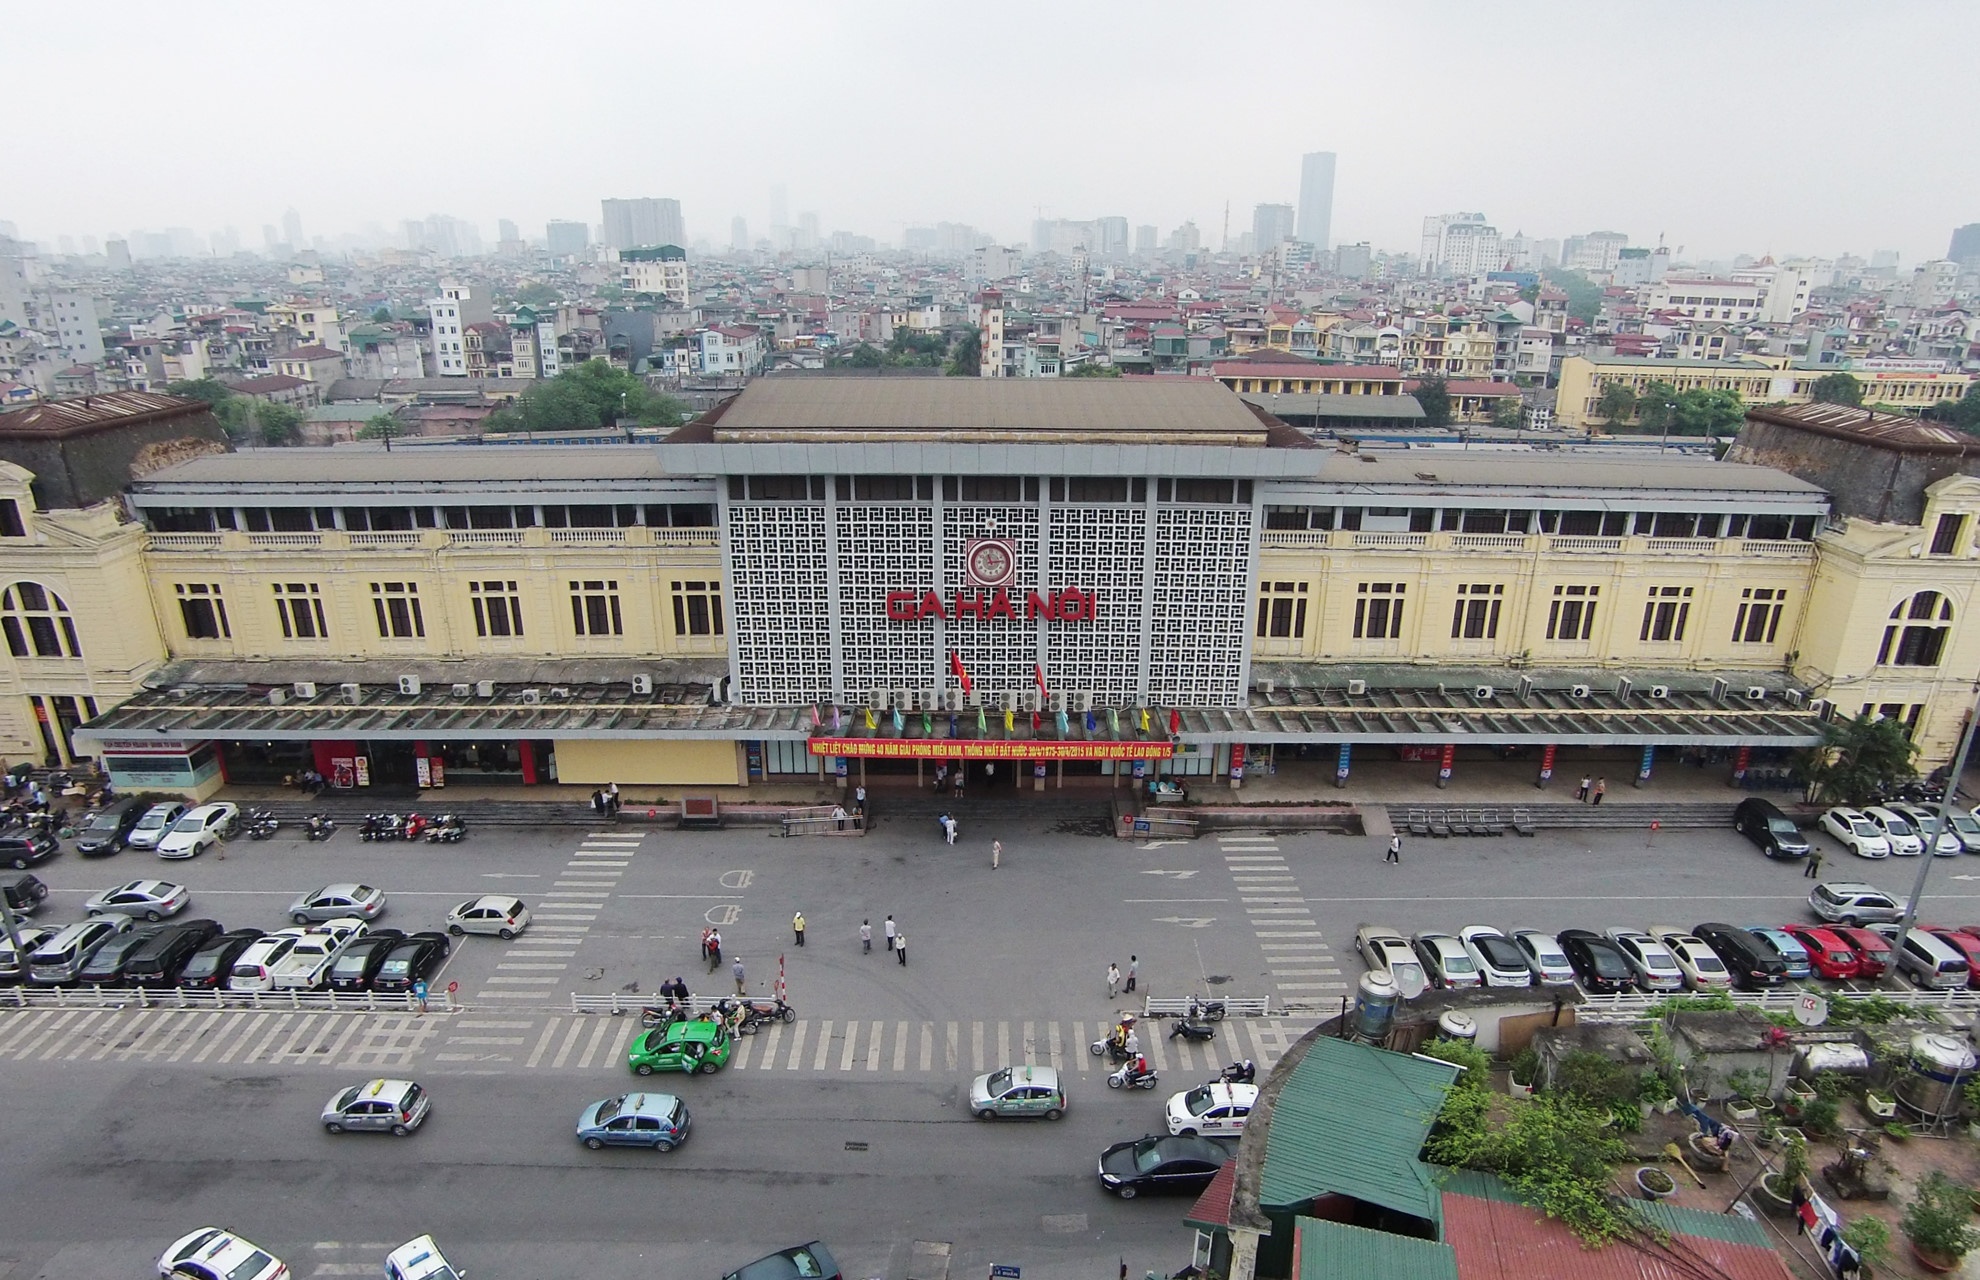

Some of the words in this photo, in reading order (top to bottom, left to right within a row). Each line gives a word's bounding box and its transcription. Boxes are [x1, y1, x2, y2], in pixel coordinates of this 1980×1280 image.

[886, 590, 947, 620] GA
[955, 587, 1017, 621] HÀ
[812, 741, 829, 755] NHIỆT
[830, 741, 841, 755] LIỆT
[842, 742, 858, 754] CHÀO
[877, 743, 885, 755] 40
[1134, 746, 1145, 756] LAO
[1162, 745, 1172, 756] 1/5
